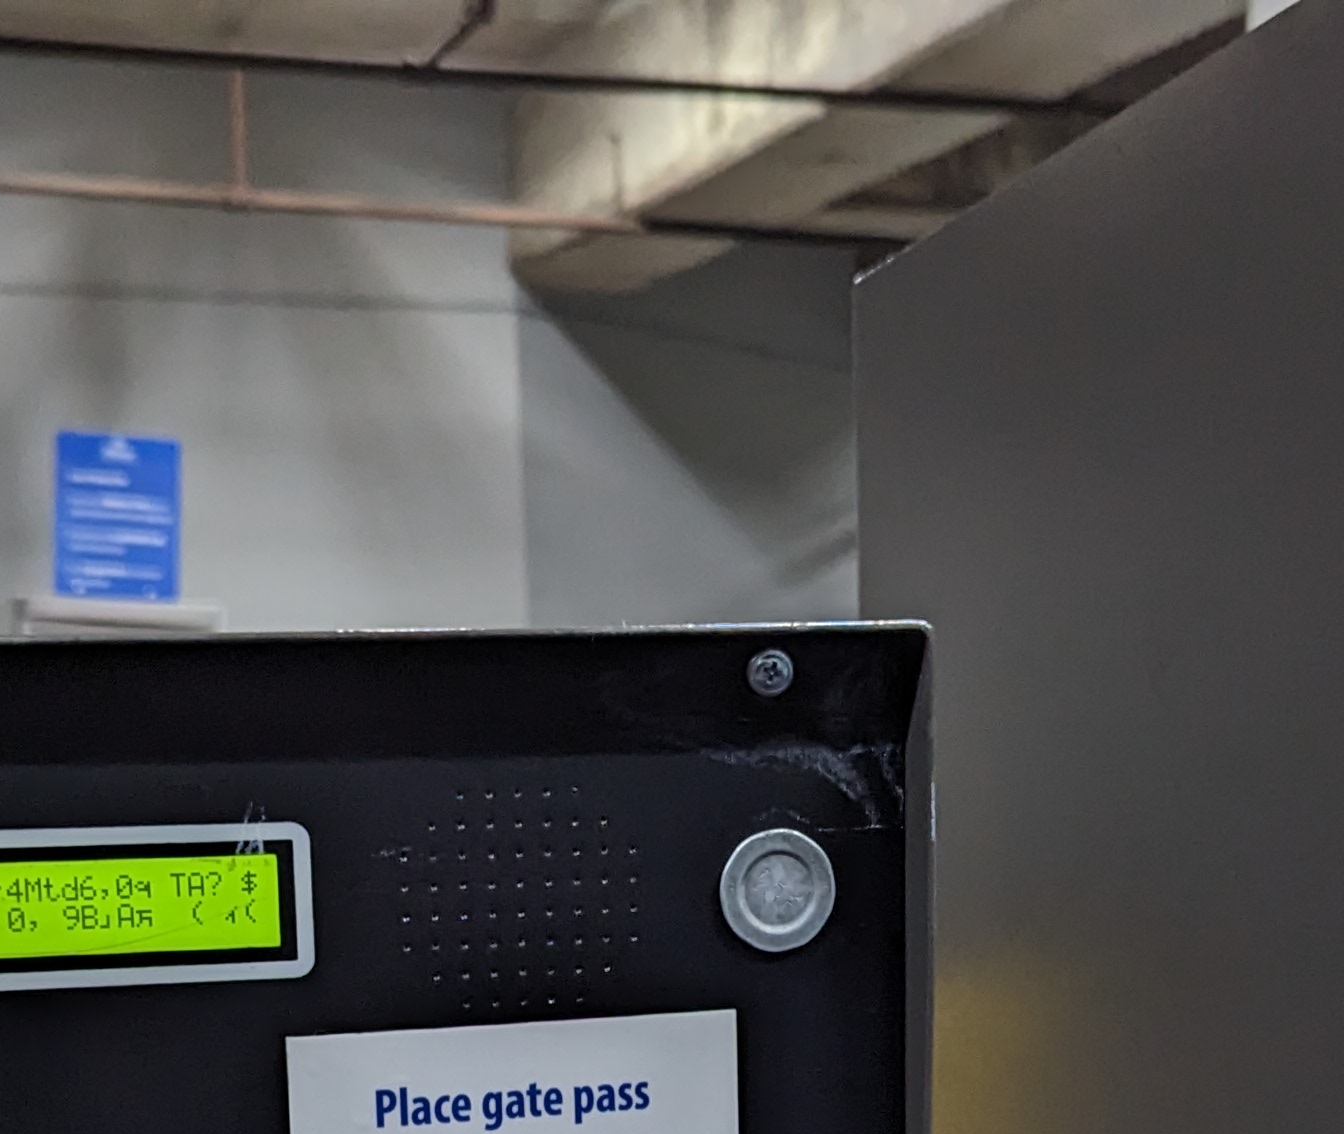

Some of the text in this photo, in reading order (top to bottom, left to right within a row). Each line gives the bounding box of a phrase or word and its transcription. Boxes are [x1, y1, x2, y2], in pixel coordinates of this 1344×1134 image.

[169, 871, 222, 898] TA?
[241, 870, 258, 896] $
[375, 1081, 651, 1131] Place gate pass
